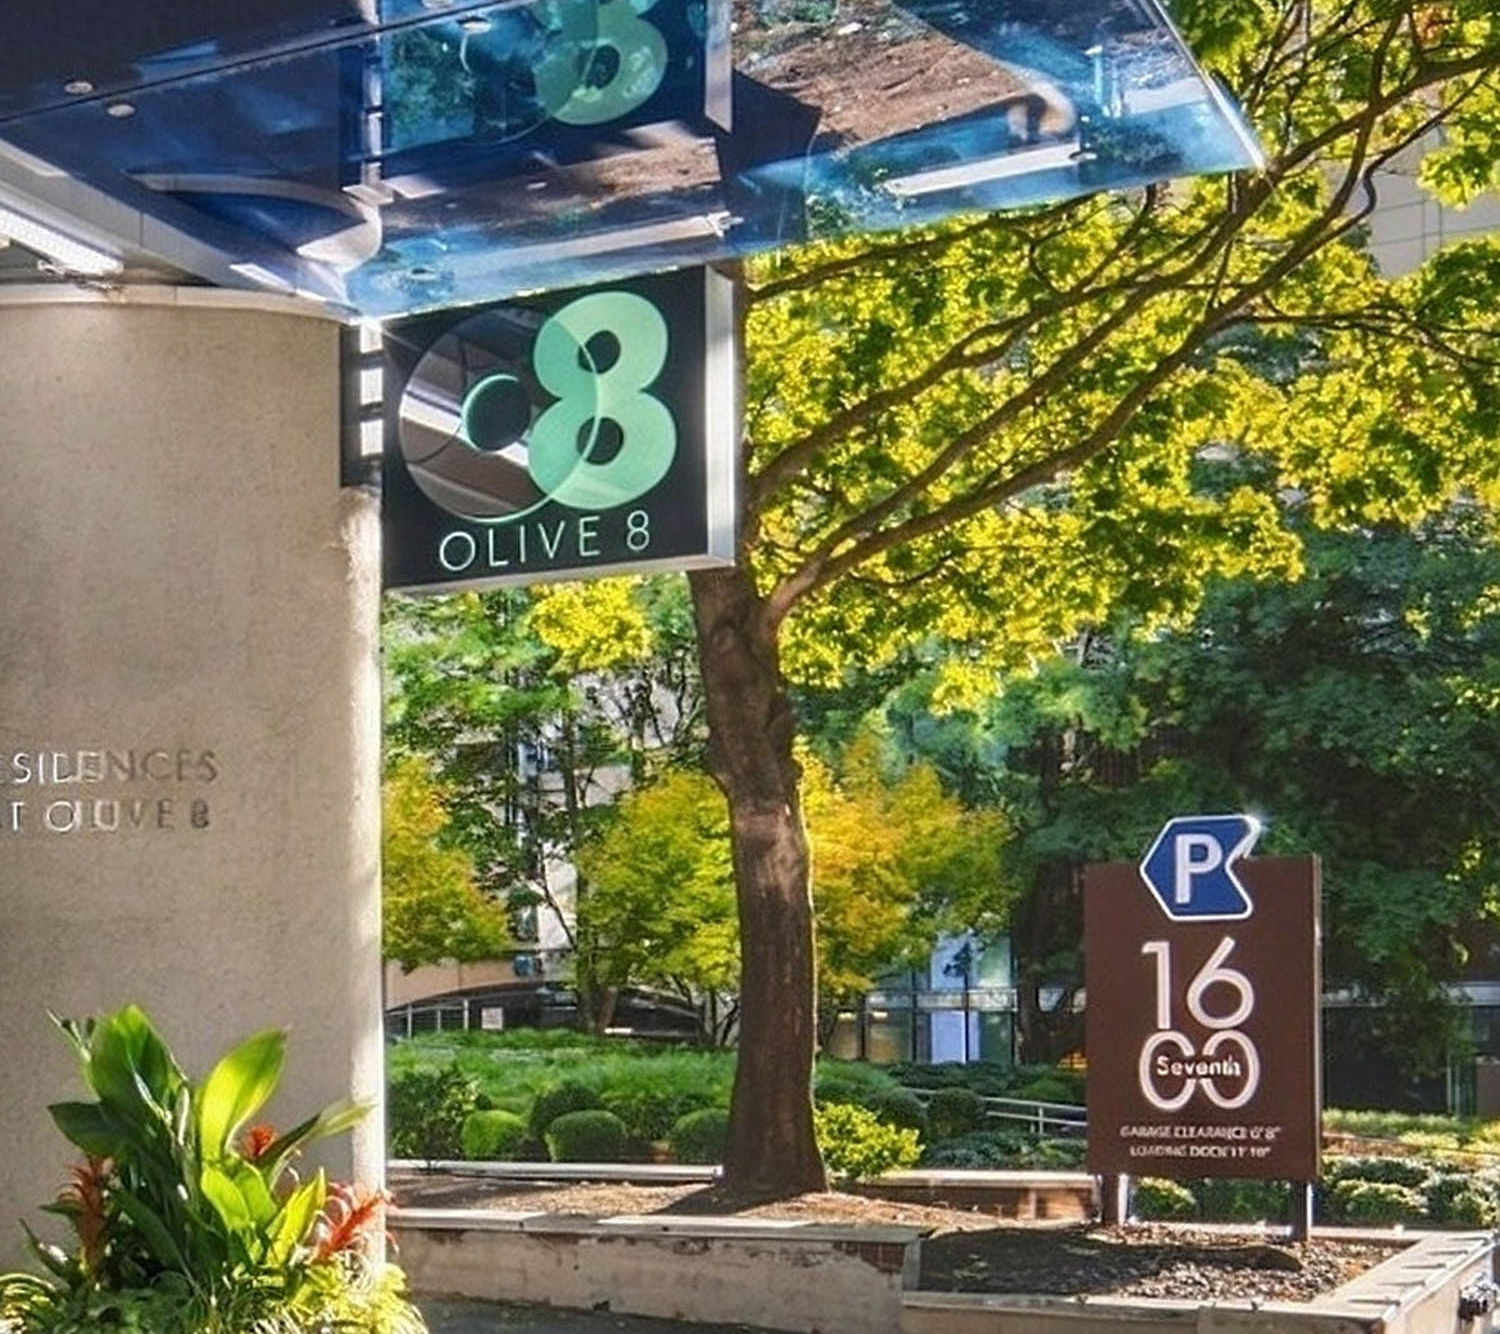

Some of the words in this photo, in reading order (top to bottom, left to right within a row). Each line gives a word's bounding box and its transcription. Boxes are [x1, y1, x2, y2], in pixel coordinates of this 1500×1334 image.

[527, 290, 678, 511] 8
[439, 515, 601, 572] OLIVE
[626, 510, 651, 552] 8
[1174, 833, 1223, 905] P
[1141, 936, 1255, 1030] 16
[1155, 1054, 1242, 1079] Seventh
[1119, 1125, 1170, 1138] GARAGE
[1173, 1125, 1248, 1140] CLEARANCE
[1129, 1144, 1187, 1157] LOADING
[1189, 1145, 1228, 1157] DOCK
